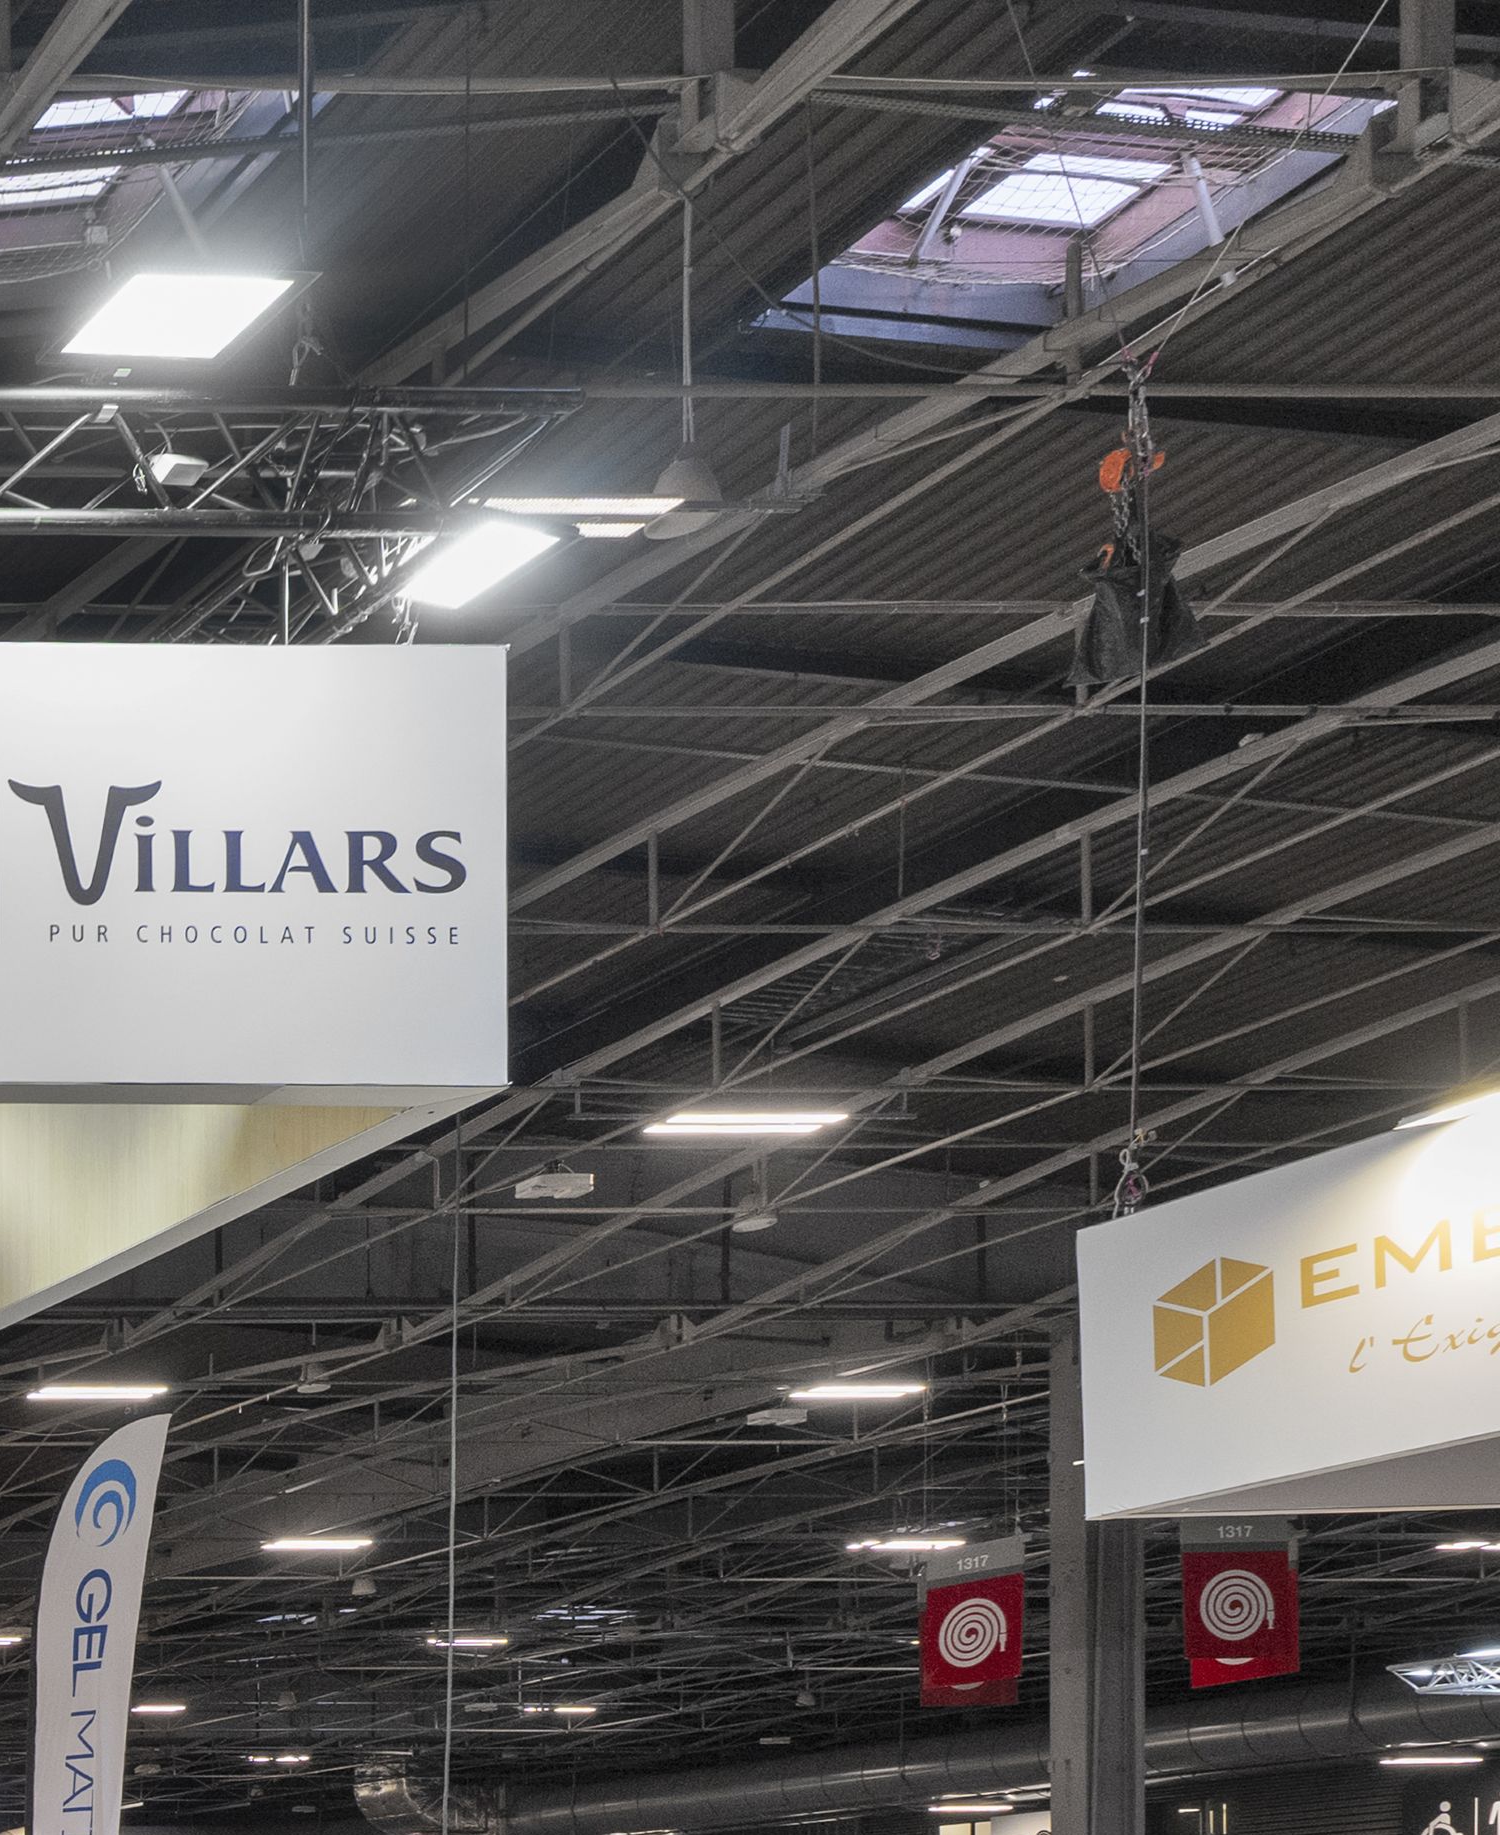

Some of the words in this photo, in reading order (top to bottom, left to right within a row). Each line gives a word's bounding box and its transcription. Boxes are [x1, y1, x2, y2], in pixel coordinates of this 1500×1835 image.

[50, 924, 109, 942] PUR
[137, 924, 316, 944] CHOCOLAT
[342, 926, 460, 945] SUISSE
[1217, 1525, 1253, 1539] 1317
[956, 1554, 989, 1571] 1317
[72, 1568, 112, 1697] GEL
